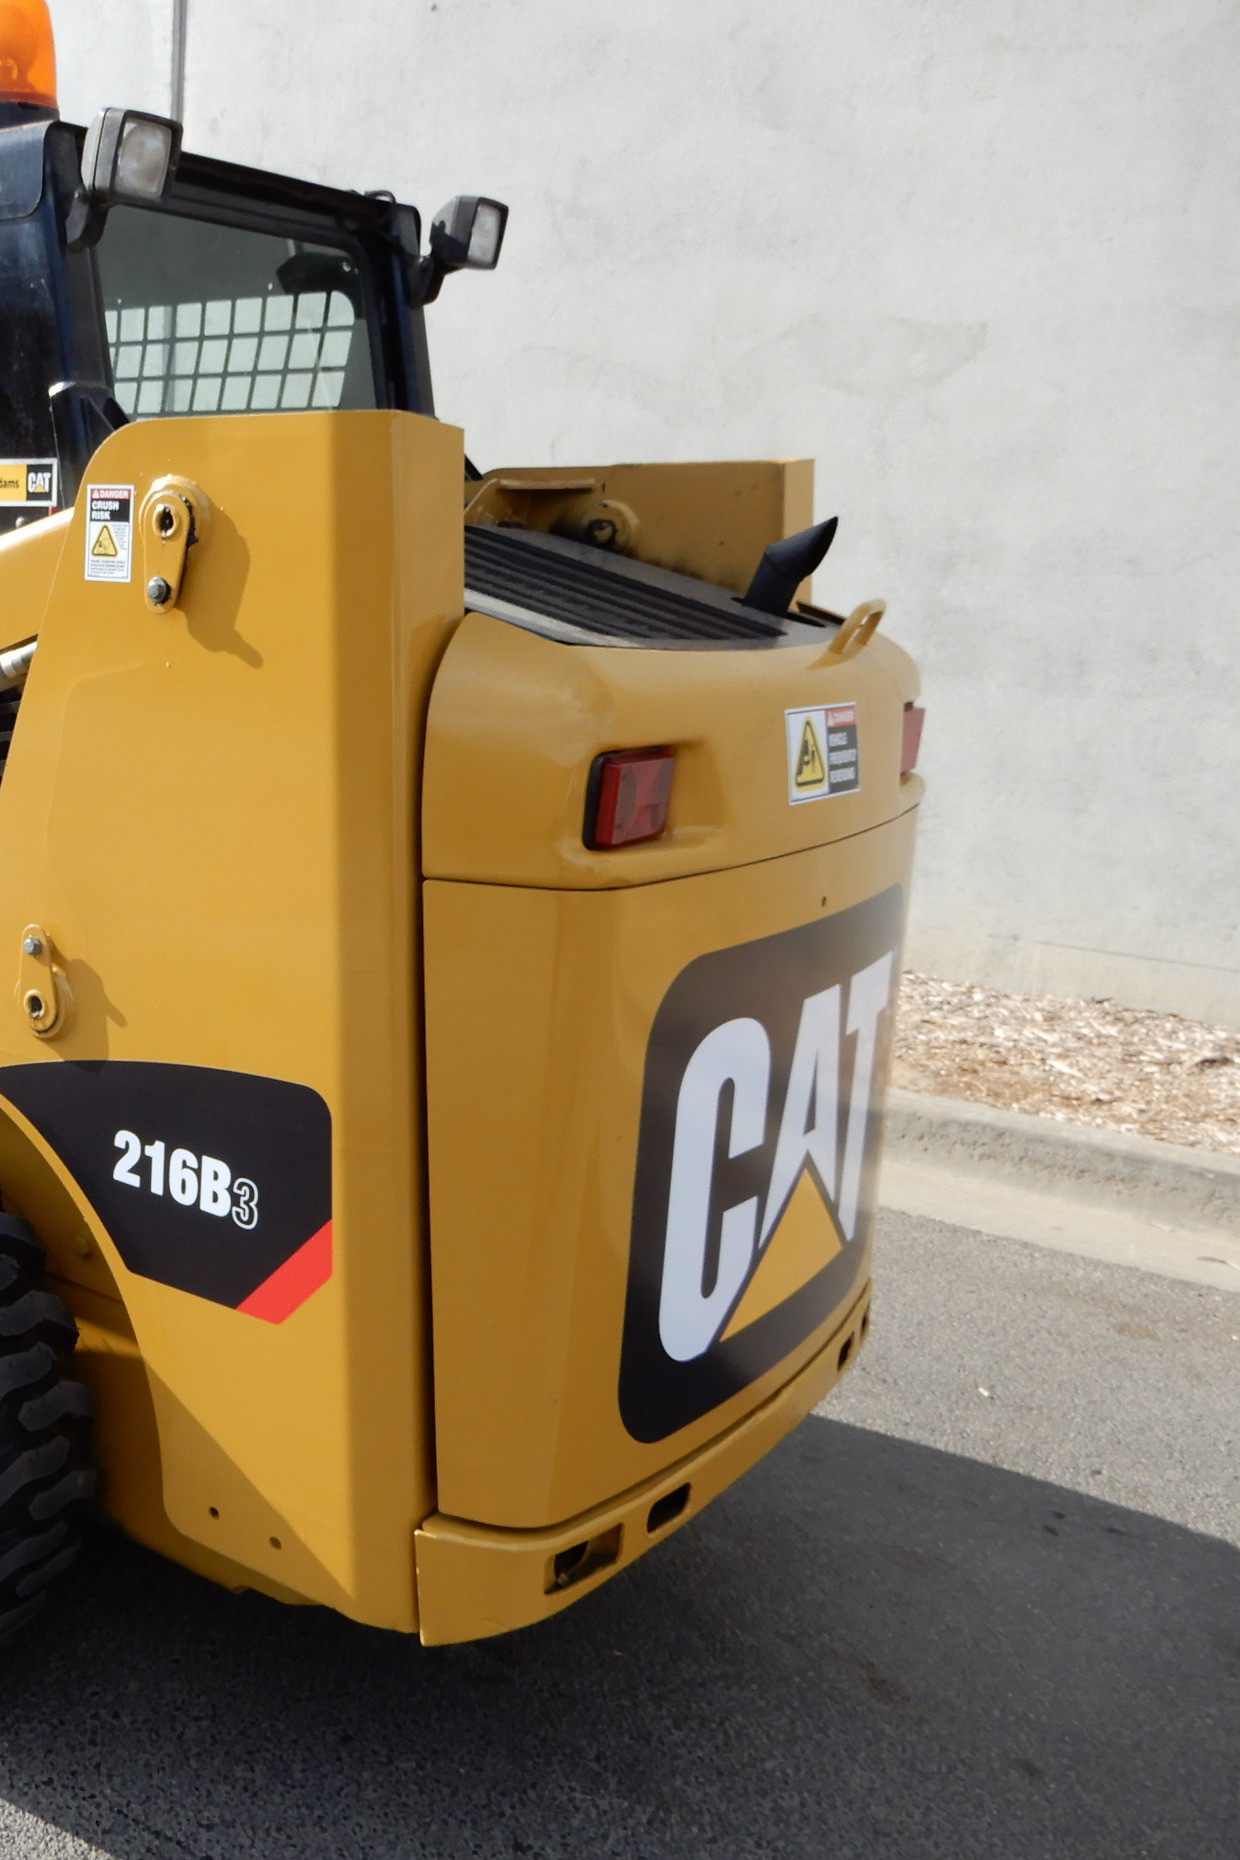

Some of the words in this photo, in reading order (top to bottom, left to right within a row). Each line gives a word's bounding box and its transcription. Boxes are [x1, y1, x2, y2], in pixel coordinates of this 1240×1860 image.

[27, 472, 51, 493] CAT
[100, 490, 128, 499] DANGER
[92, 501, 120, 511] CRUSH
[92, 511, 111, 520] RISK
[659, 952, 891, 1362] CAT
[112, 1129, 259, 1230] 216B3
